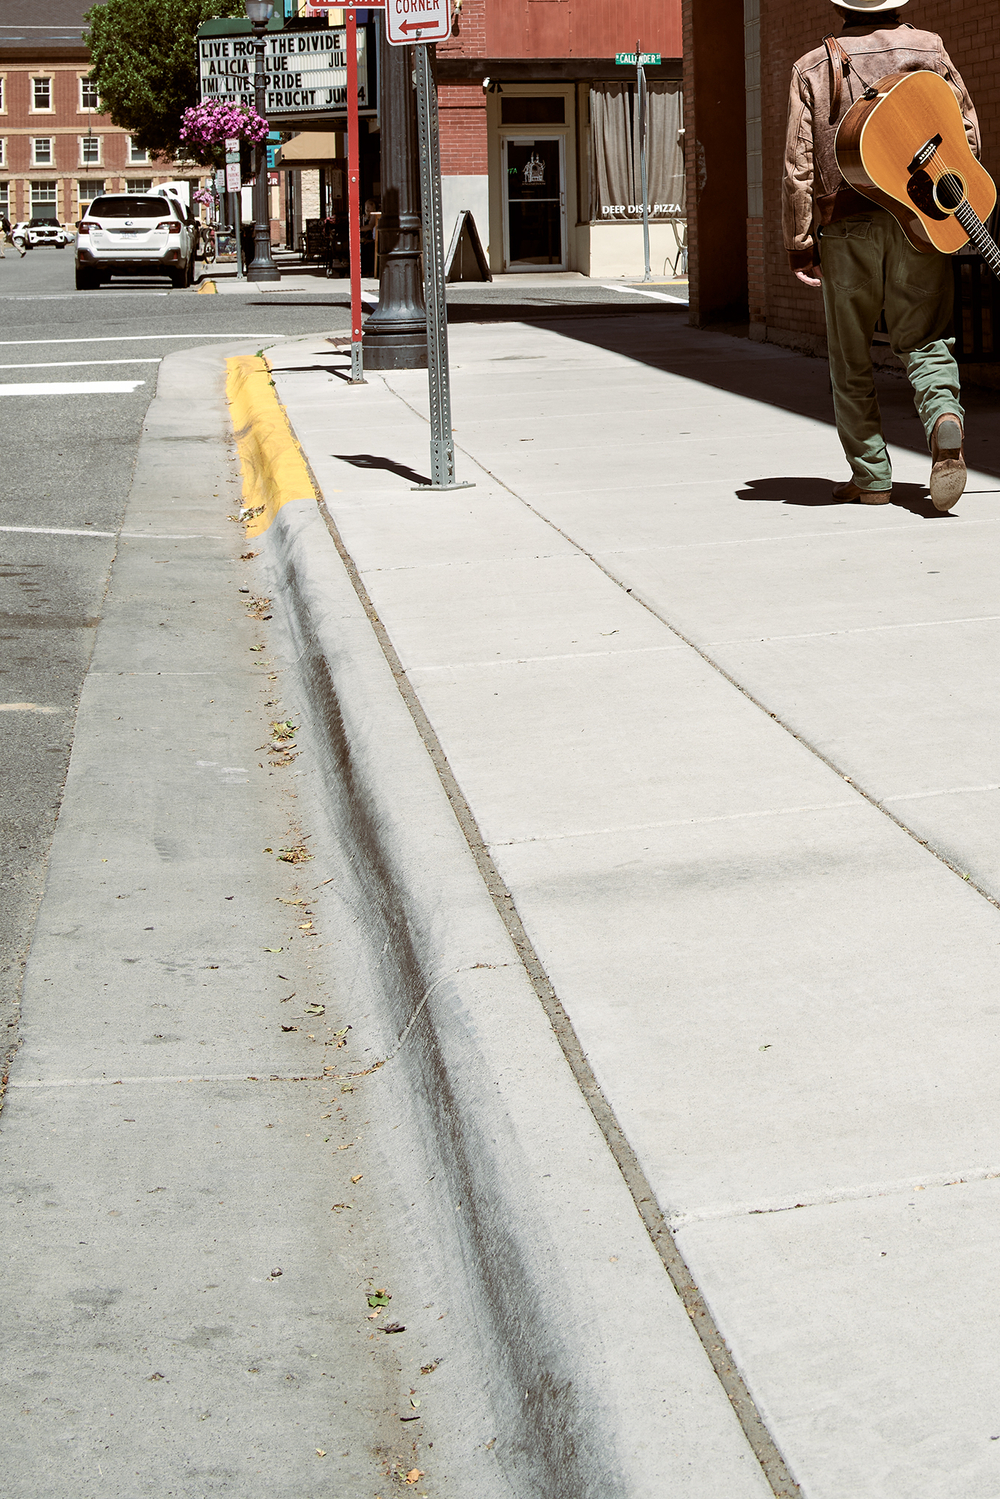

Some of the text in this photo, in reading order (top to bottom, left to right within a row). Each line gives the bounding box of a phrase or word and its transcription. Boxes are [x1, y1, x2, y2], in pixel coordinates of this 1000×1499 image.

[202, 34, 341, 58] LIVE FRO THE DIVIDE
[209, 59, 249, 75] ALICIA
[265, 56, 289, 72] LUE
[201, 73, 302, 93] TMI LIVE PRIDE
[268, 90, 316, 108] FRUCHT
[602, 203, 682, 214] DEEP DISH PIZZA
